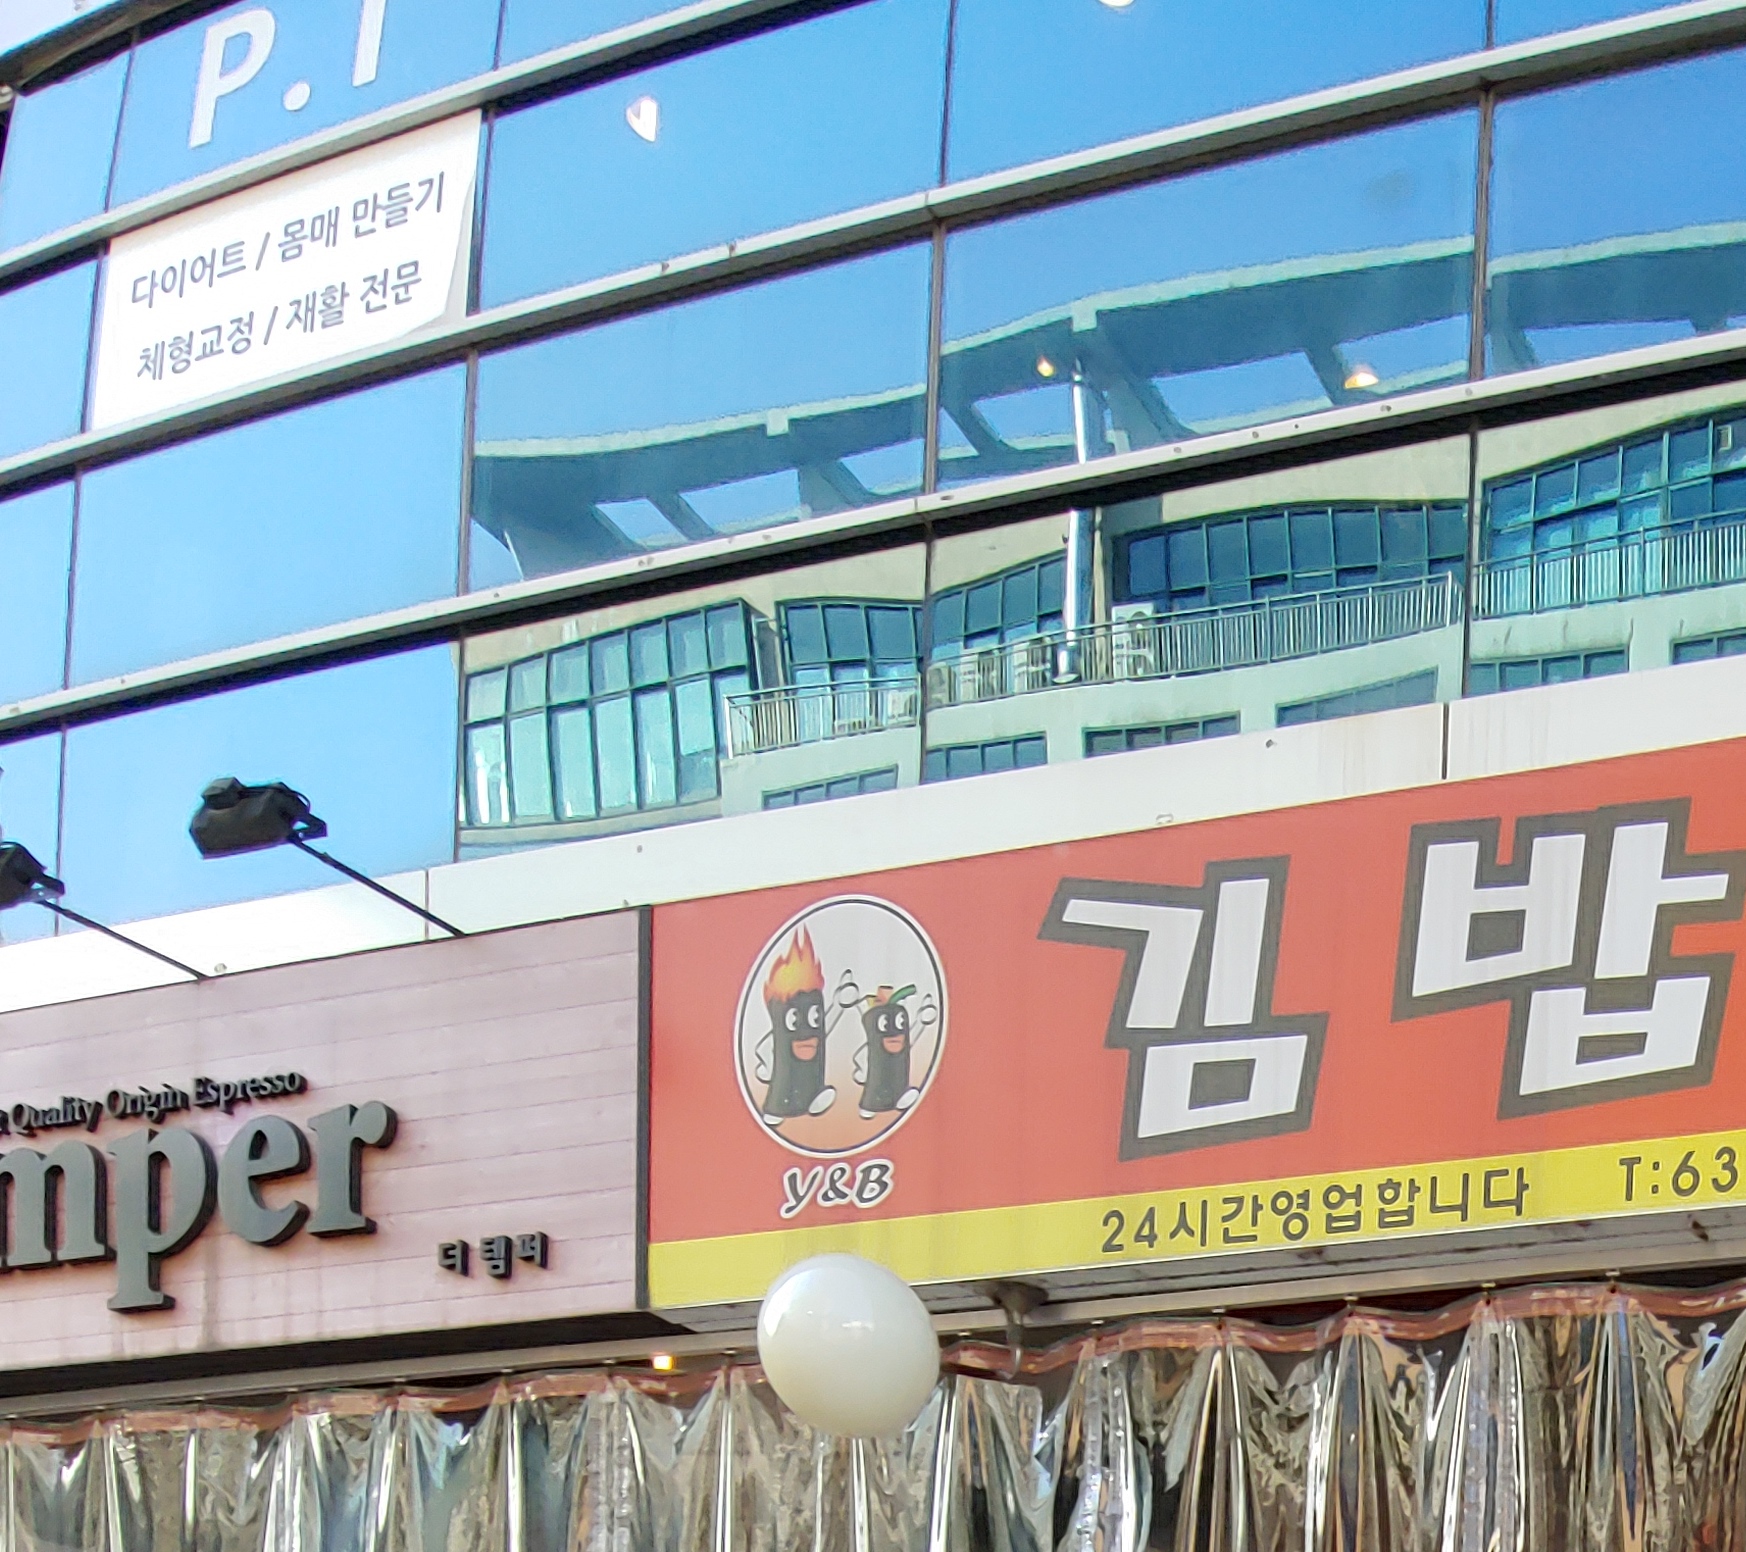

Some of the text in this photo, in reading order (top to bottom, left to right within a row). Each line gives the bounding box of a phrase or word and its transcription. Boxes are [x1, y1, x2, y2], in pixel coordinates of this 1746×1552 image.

[132, 240, 246, 308] 다이어트
[278, 206, 340, 262] 몸매
[353, 171, 444, 238] 만들기
[137, 311, 254, 380] 체형교정
[286, 281, 349, 333] 재활
[360, 260, 422, 313] 전문
[11, 1096, 103, 1136] Quality
[106, 1083, 191, 1123] Origin
[193, 1072, 308, 1115] Espresso
[1102, 1167, 1529, 1253] 24시간영업합니다
